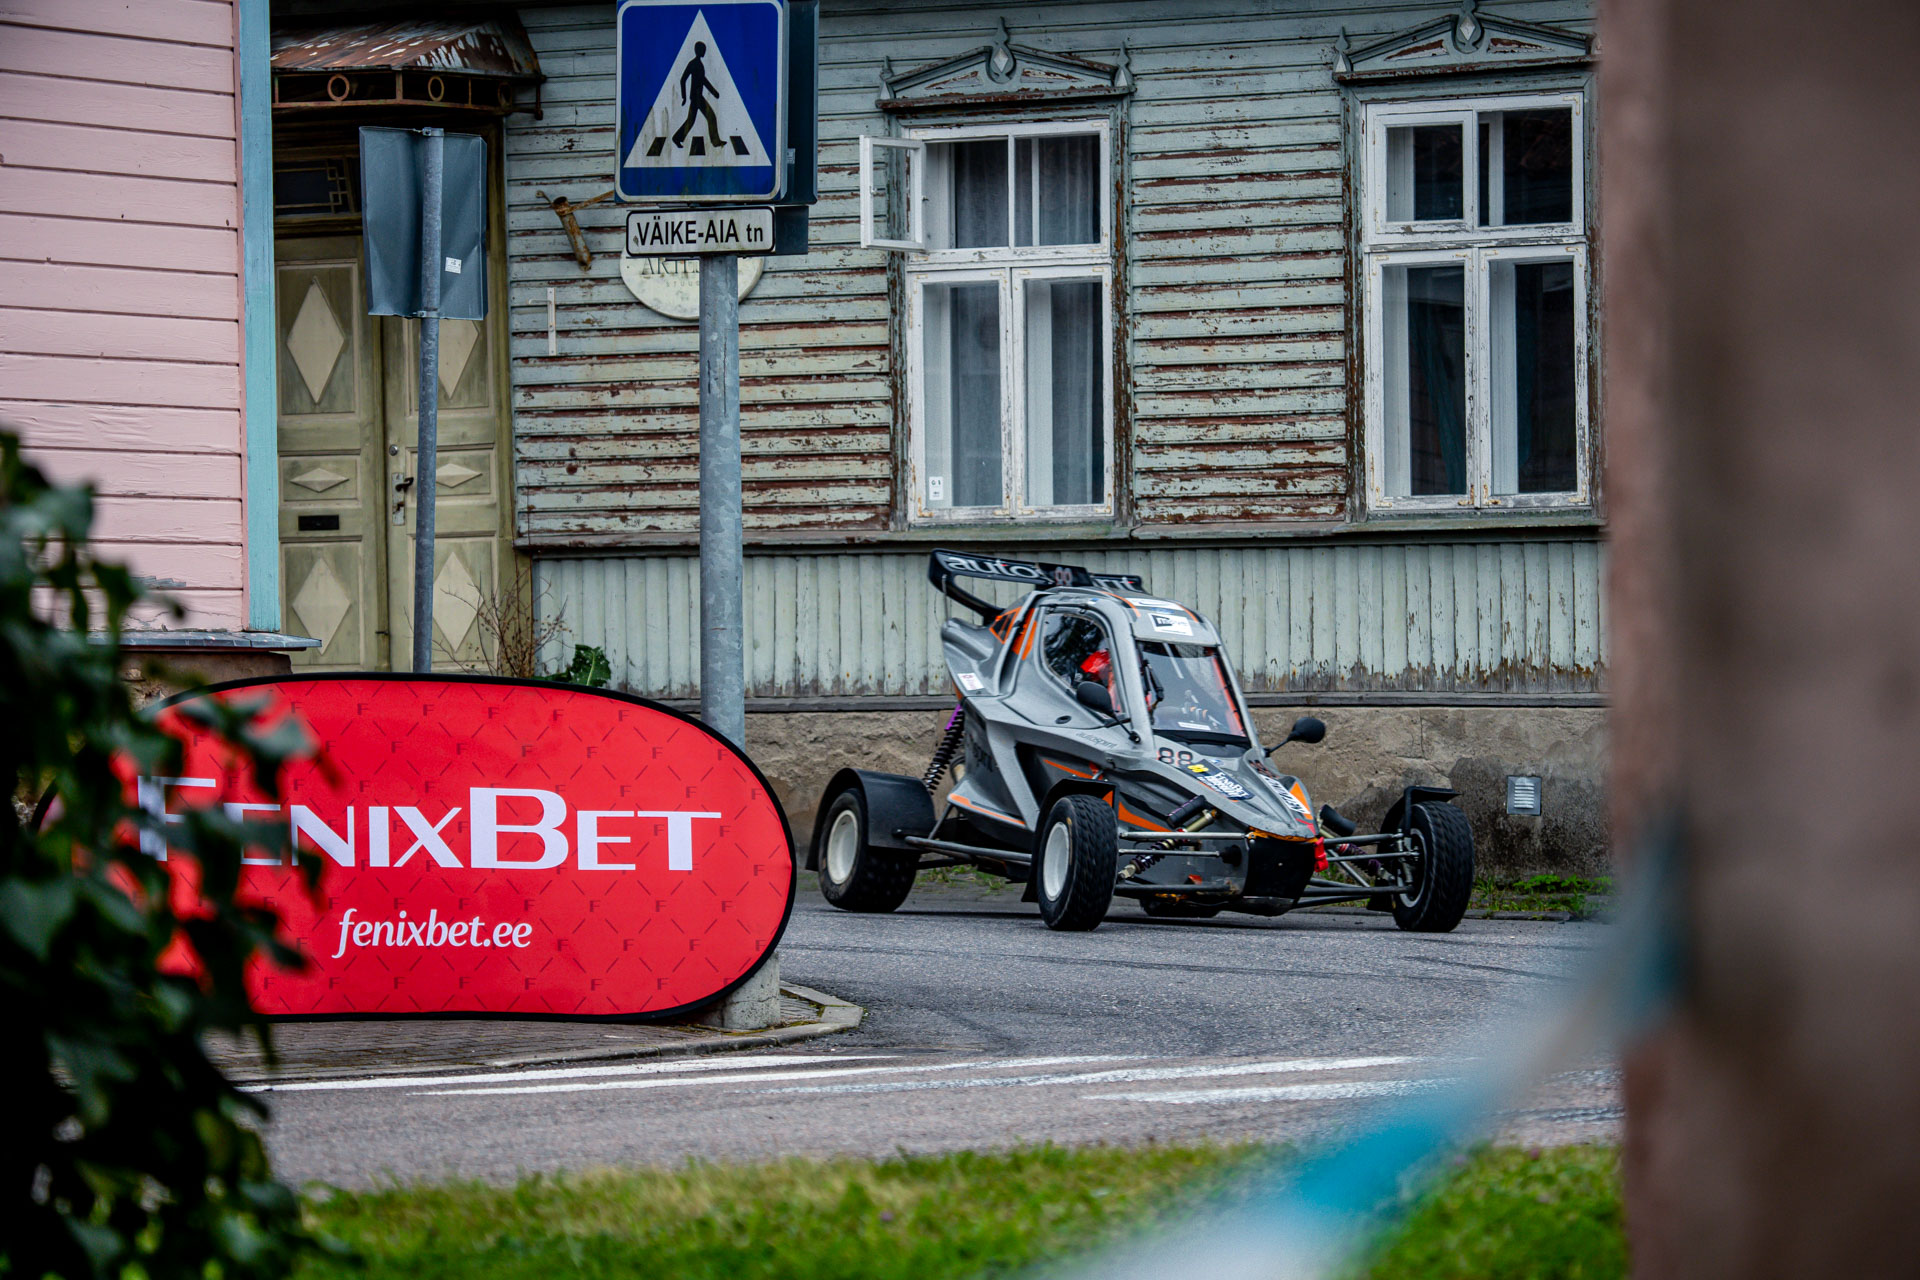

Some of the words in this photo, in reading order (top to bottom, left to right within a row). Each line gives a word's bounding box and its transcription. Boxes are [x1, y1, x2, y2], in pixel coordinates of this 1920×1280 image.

[637, 215, 739, 246] VÄIKE-AIA
[746, 223, 763, 242] tn
[1156, 747, 1194, 767] 88
[332, 908, 533, 959] fenixbet.ee
